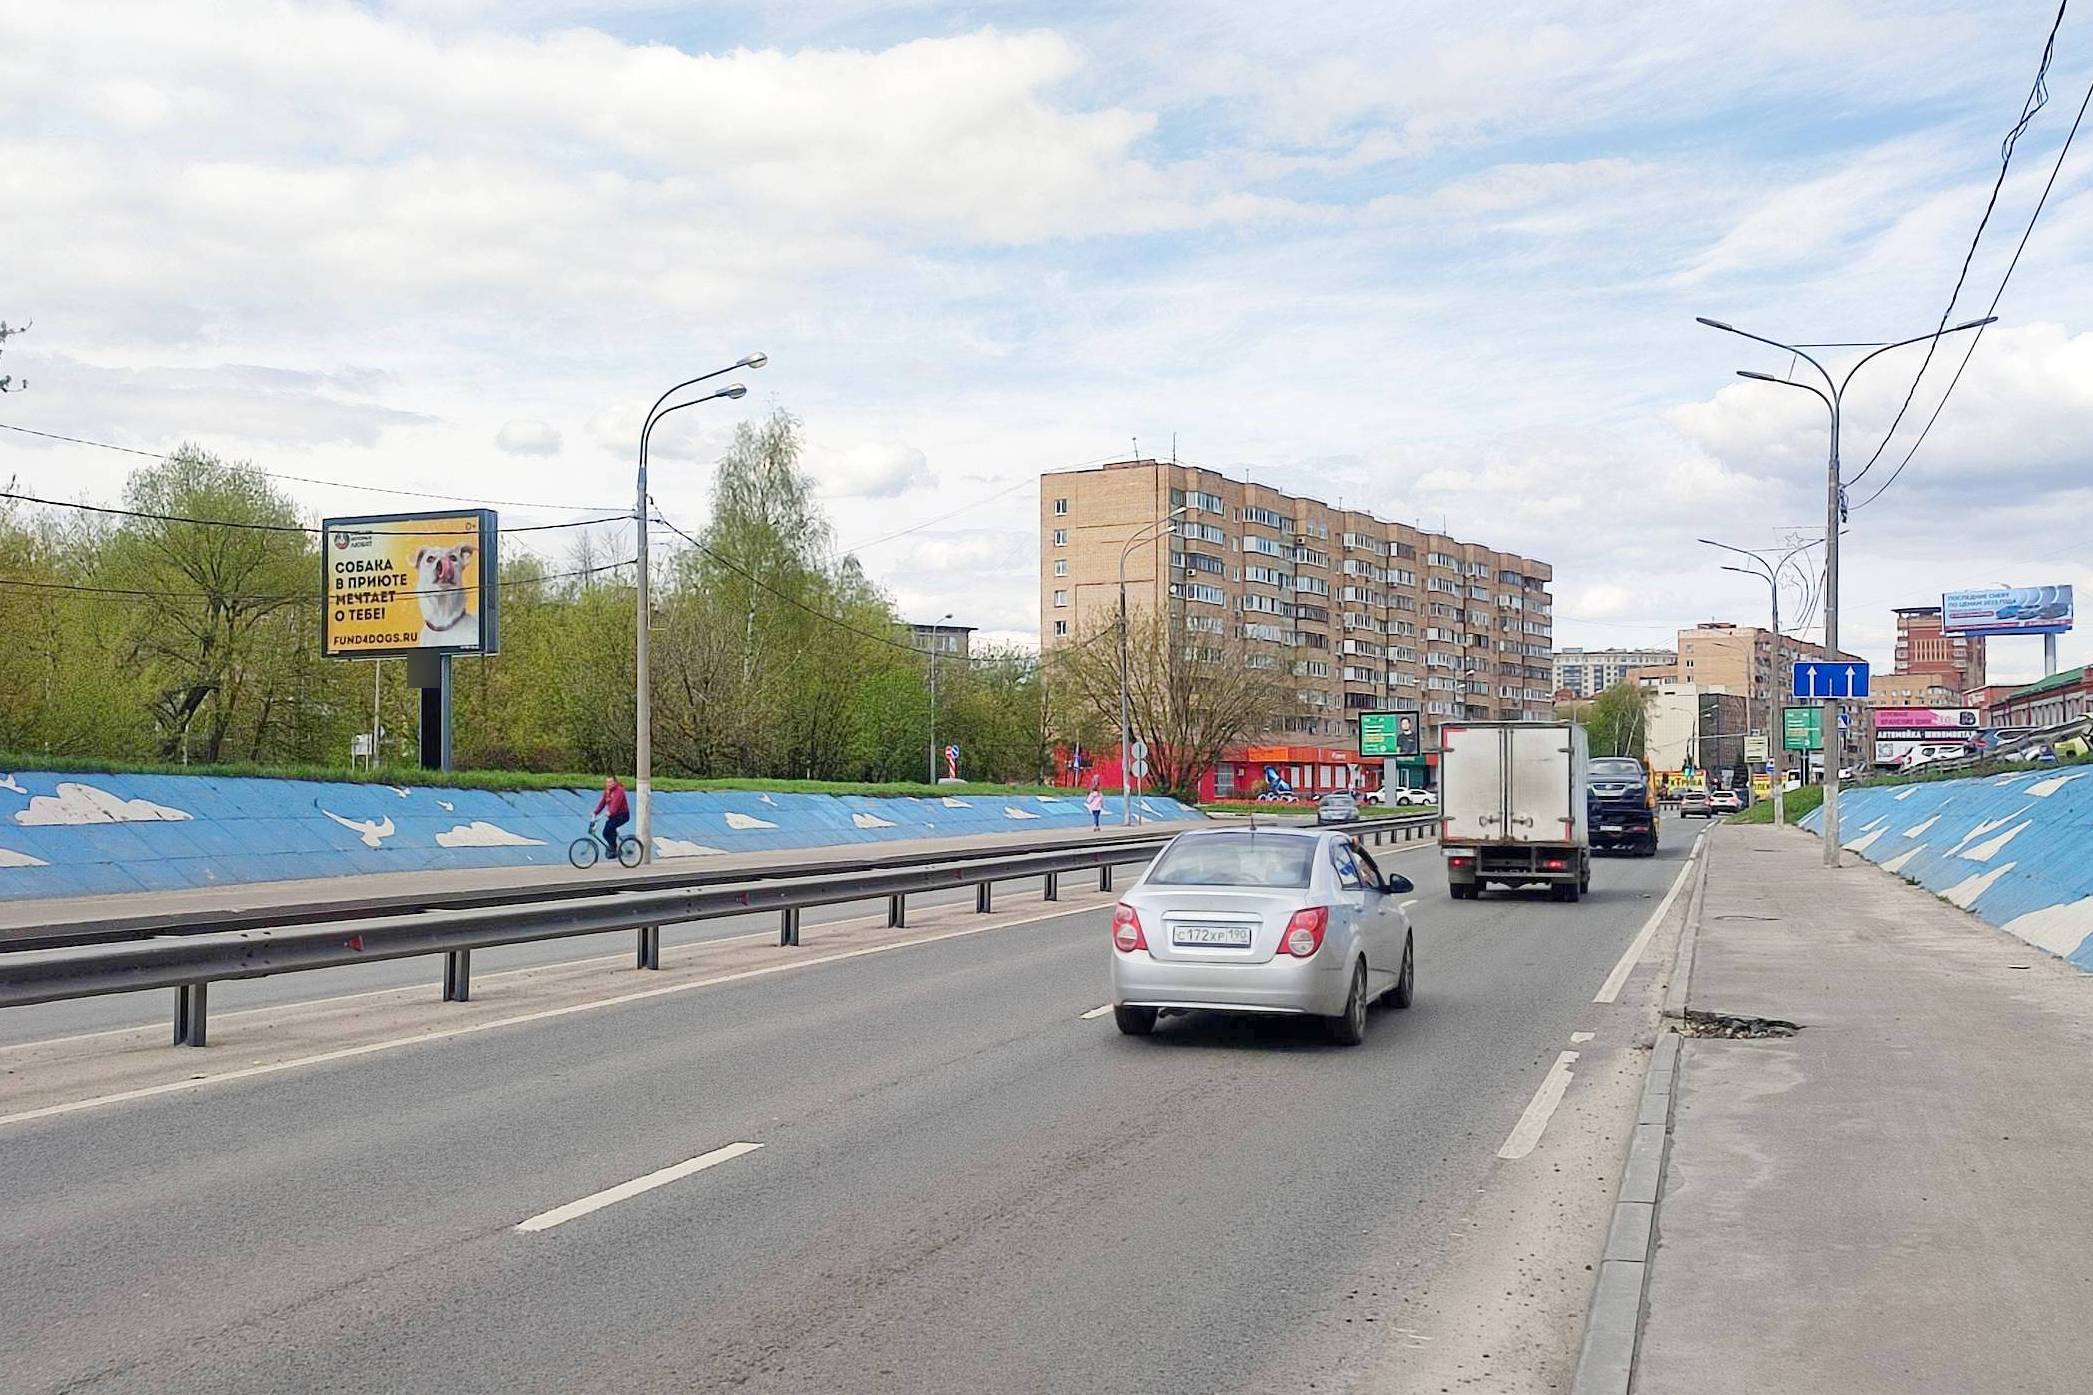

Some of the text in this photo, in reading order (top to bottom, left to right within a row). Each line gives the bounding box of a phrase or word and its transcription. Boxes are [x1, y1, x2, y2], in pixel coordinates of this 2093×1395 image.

[335, 559, 393, 573] СОБАКА
[336, 574, 407, 589] В ПРИЮТЕ
[336, 591, 396, 605] МЕЧТАЕТ
[335, 607, 385, 621] О ТЕБЕ!
[333, 632, 418, 645] FUND4DOGS.RU
[1877, 729, 1921, 739] АВТОМОЙКА
